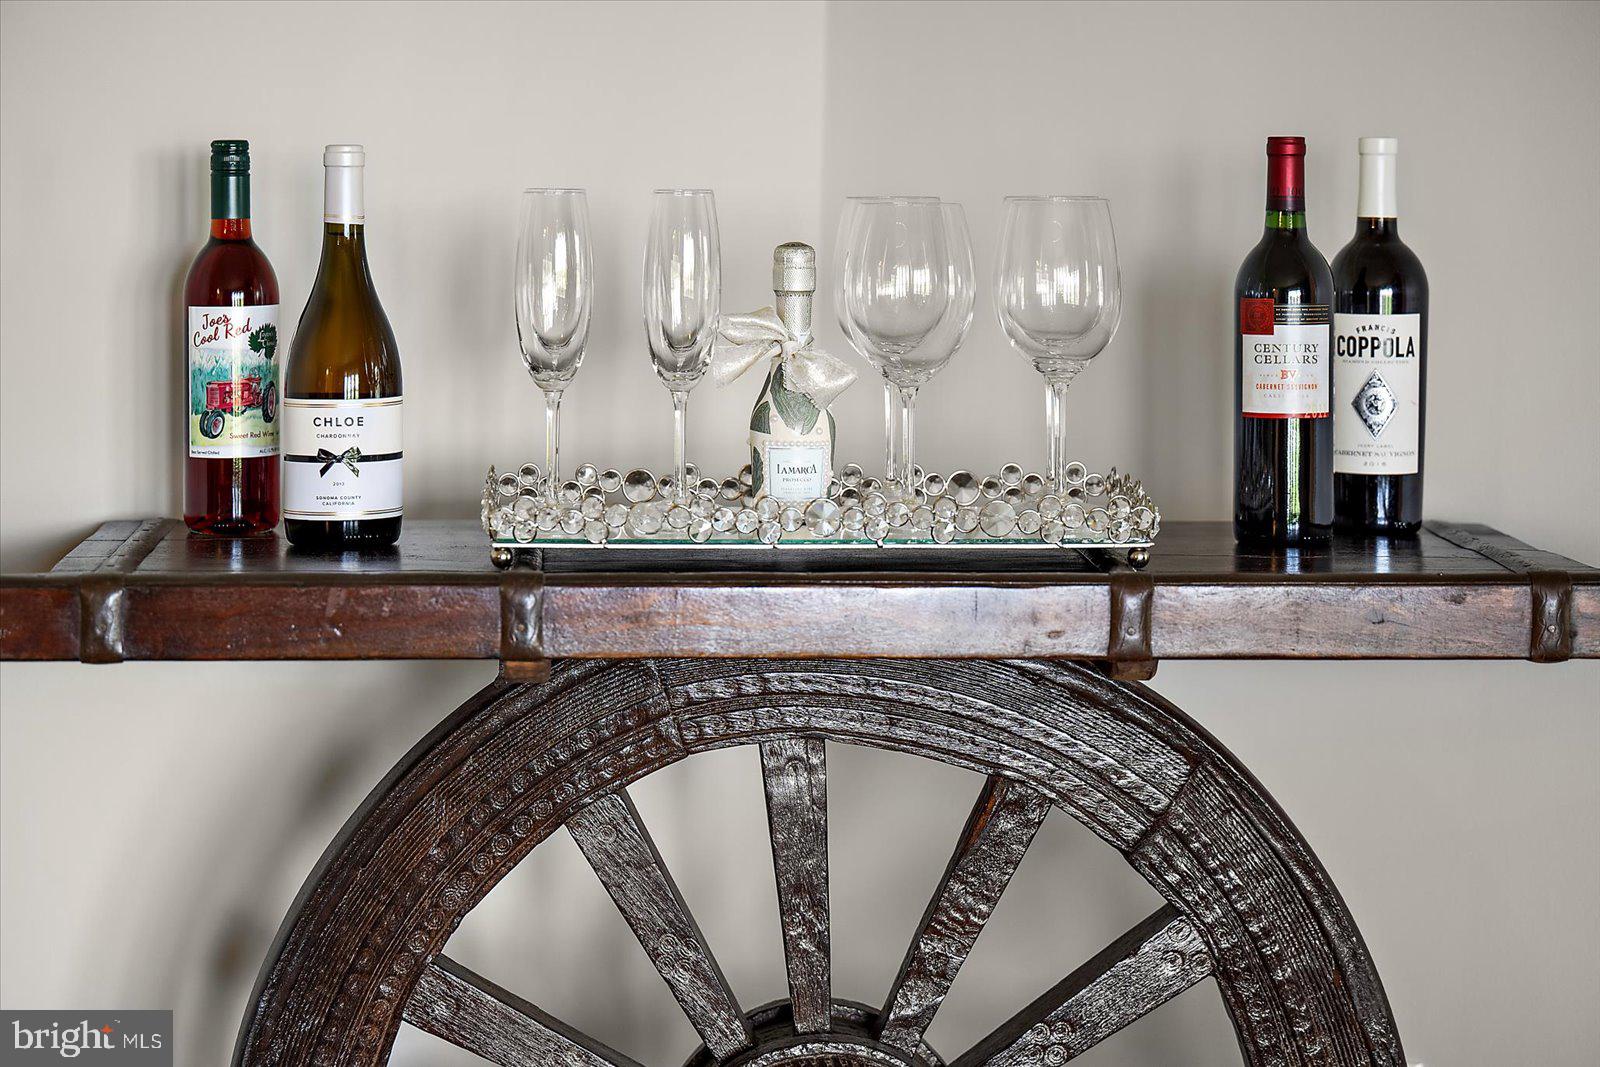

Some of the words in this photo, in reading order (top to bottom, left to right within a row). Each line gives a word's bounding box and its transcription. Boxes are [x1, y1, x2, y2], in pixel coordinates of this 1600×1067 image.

[202, 313, 231, 330] Joe's
[193, 327, 220, 348] Cool
[225, 317, 252, 339] Red
[1254, 343, 1319, 353] CENTURY
[1337, 335, 1415, 358] COPPOLA
[1254, 354, 1319, 364] CELLARS
[313, 416, 364, 427] CHLOE
